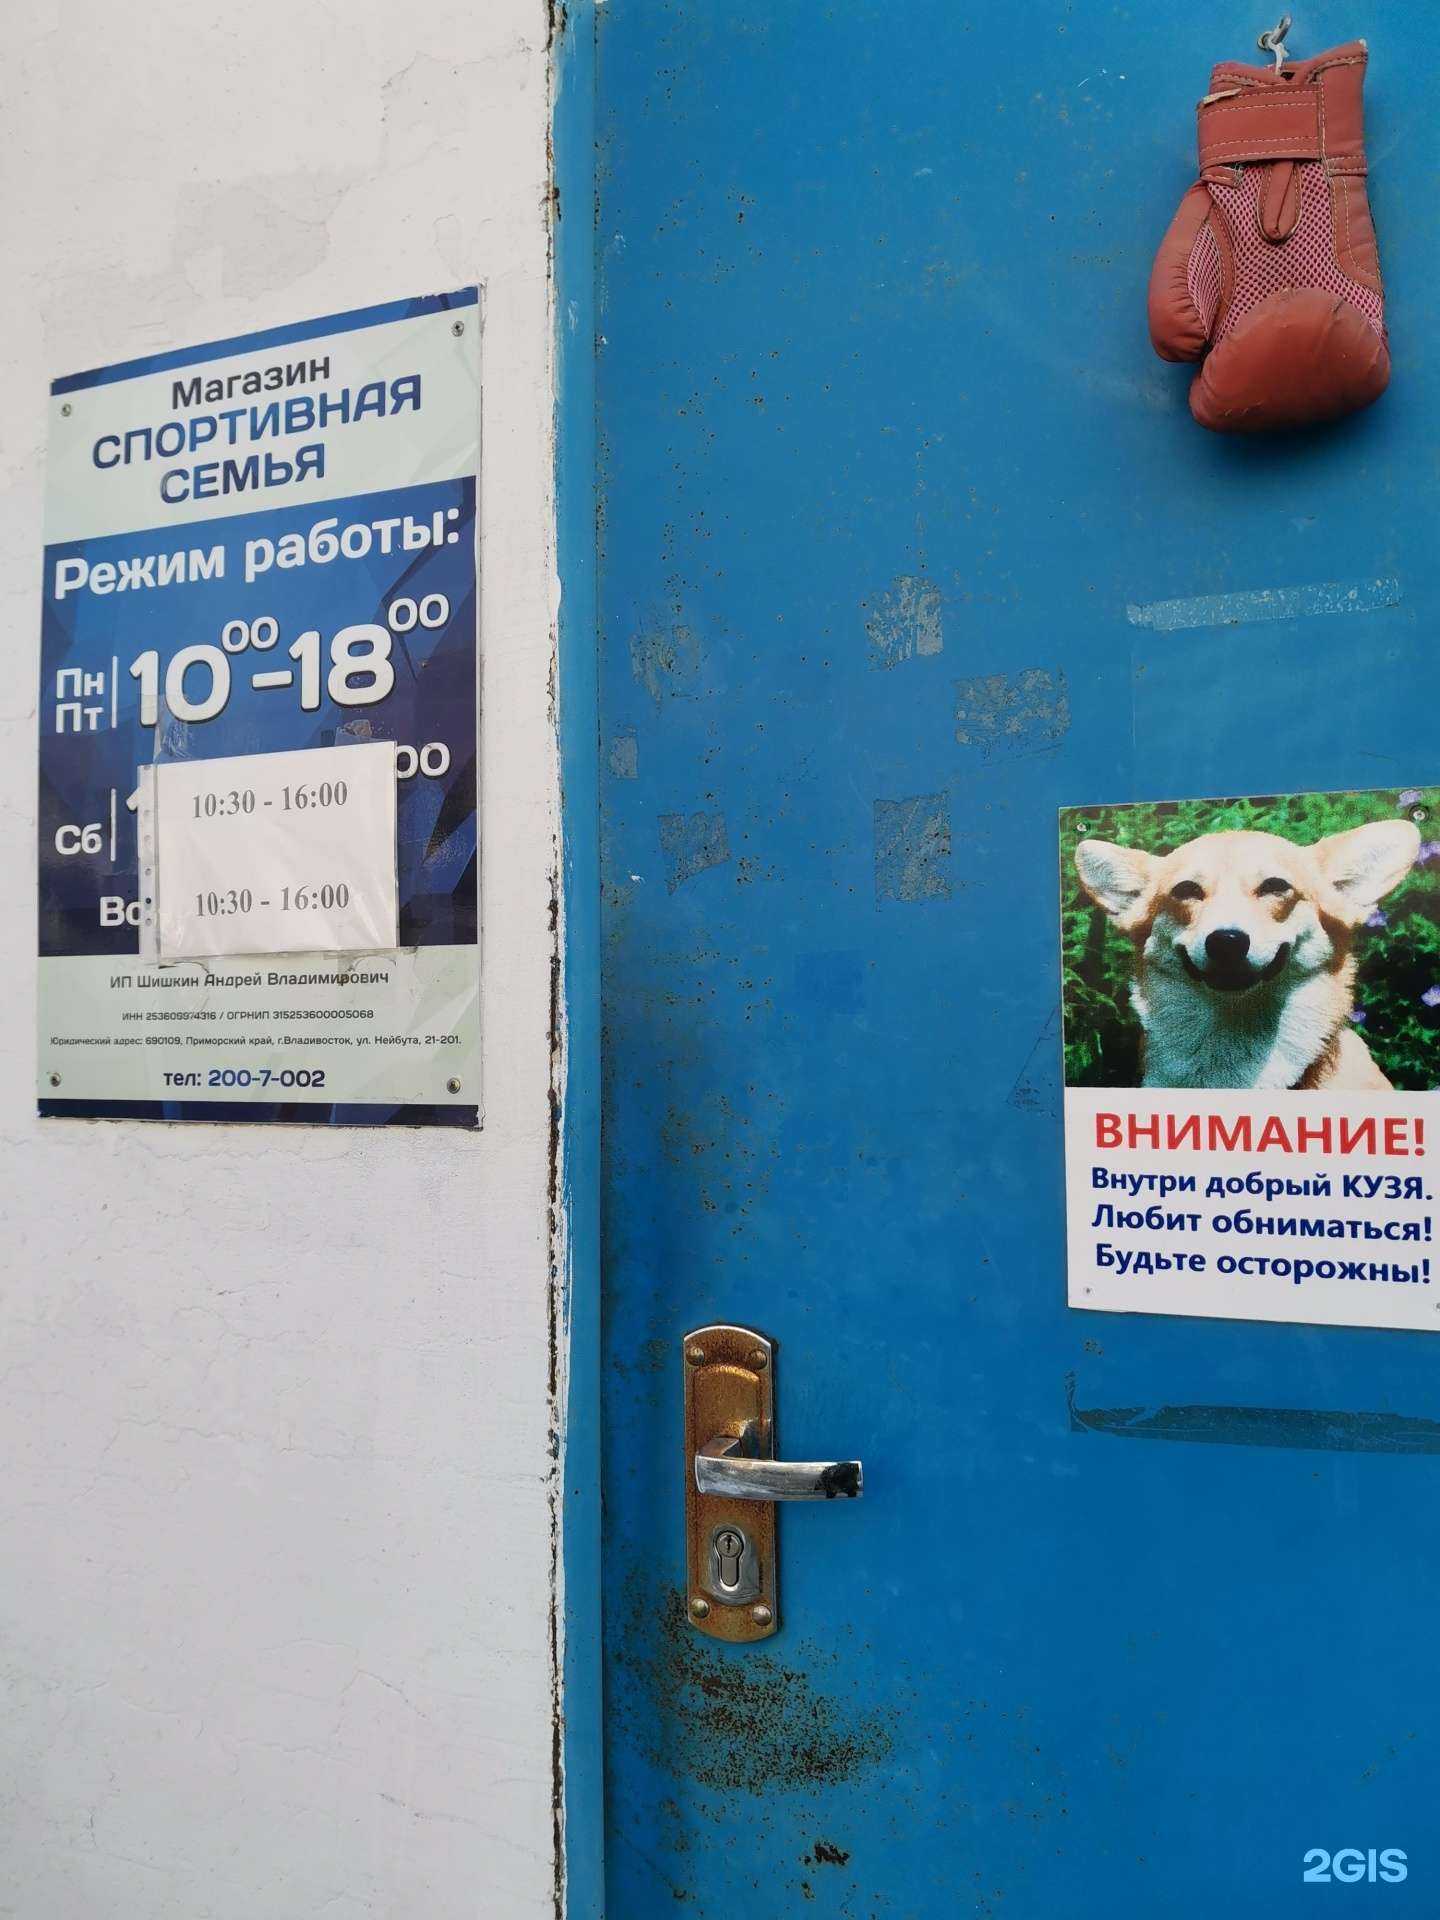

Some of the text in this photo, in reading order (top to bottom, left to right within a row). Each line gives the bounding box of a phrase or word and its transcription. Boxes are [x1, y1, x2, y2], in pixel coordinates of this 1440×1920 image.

[171, 356, 330, 409] Магазин
[92, 374, 422, 469] СПОРТИВНАЯ
[160, 443, 326, 504] СЕМЬЯ
[54, 507, 460, 600] Режим работы:
[56, 667, 104, 698] Пн
[56, 703, 104, 733] Пт
[192, 789, 256, 818] 10:30
[281, 780, 348, 811] 16:00
[54, 823, 102, 855] Сб
[196, 888, 253, 917] 10:30
[280, 883, 349, 911] 16:00
[110, 971, 389, 989] ИП Шишкин Андрей Владимирович
[122, 1012, 143, 1020] ИНН
[227, 1010, 270, 1020] ОГРНИП
[272, 1009, 374, 1019] 315253600005068
[50, 1036, 111, 1046] Юридический
[113, 1038, 142, 1046] адрес:
[145, 1036, 183, 1046] 690109,
[185, 1035, 246, 1046] Приморский
[248, 1035, 275, 1046] край,
[356, 1037, 371, 1046] ул.
[374, 1035, 421, 1046] Нейбута,
[163, 1070, 326, 1087] тел: 200-7-002
[1095, 1112, 1426, 1157] ВНИМАНИЕ!
[1091, 1166, 1434, 1201] Внутри добрый КУЗЯ.
[1091, 1204, 1433, 1242] Любит обниматься!
[1096, 1243, 1431, 1285] Будьте осторожны!
